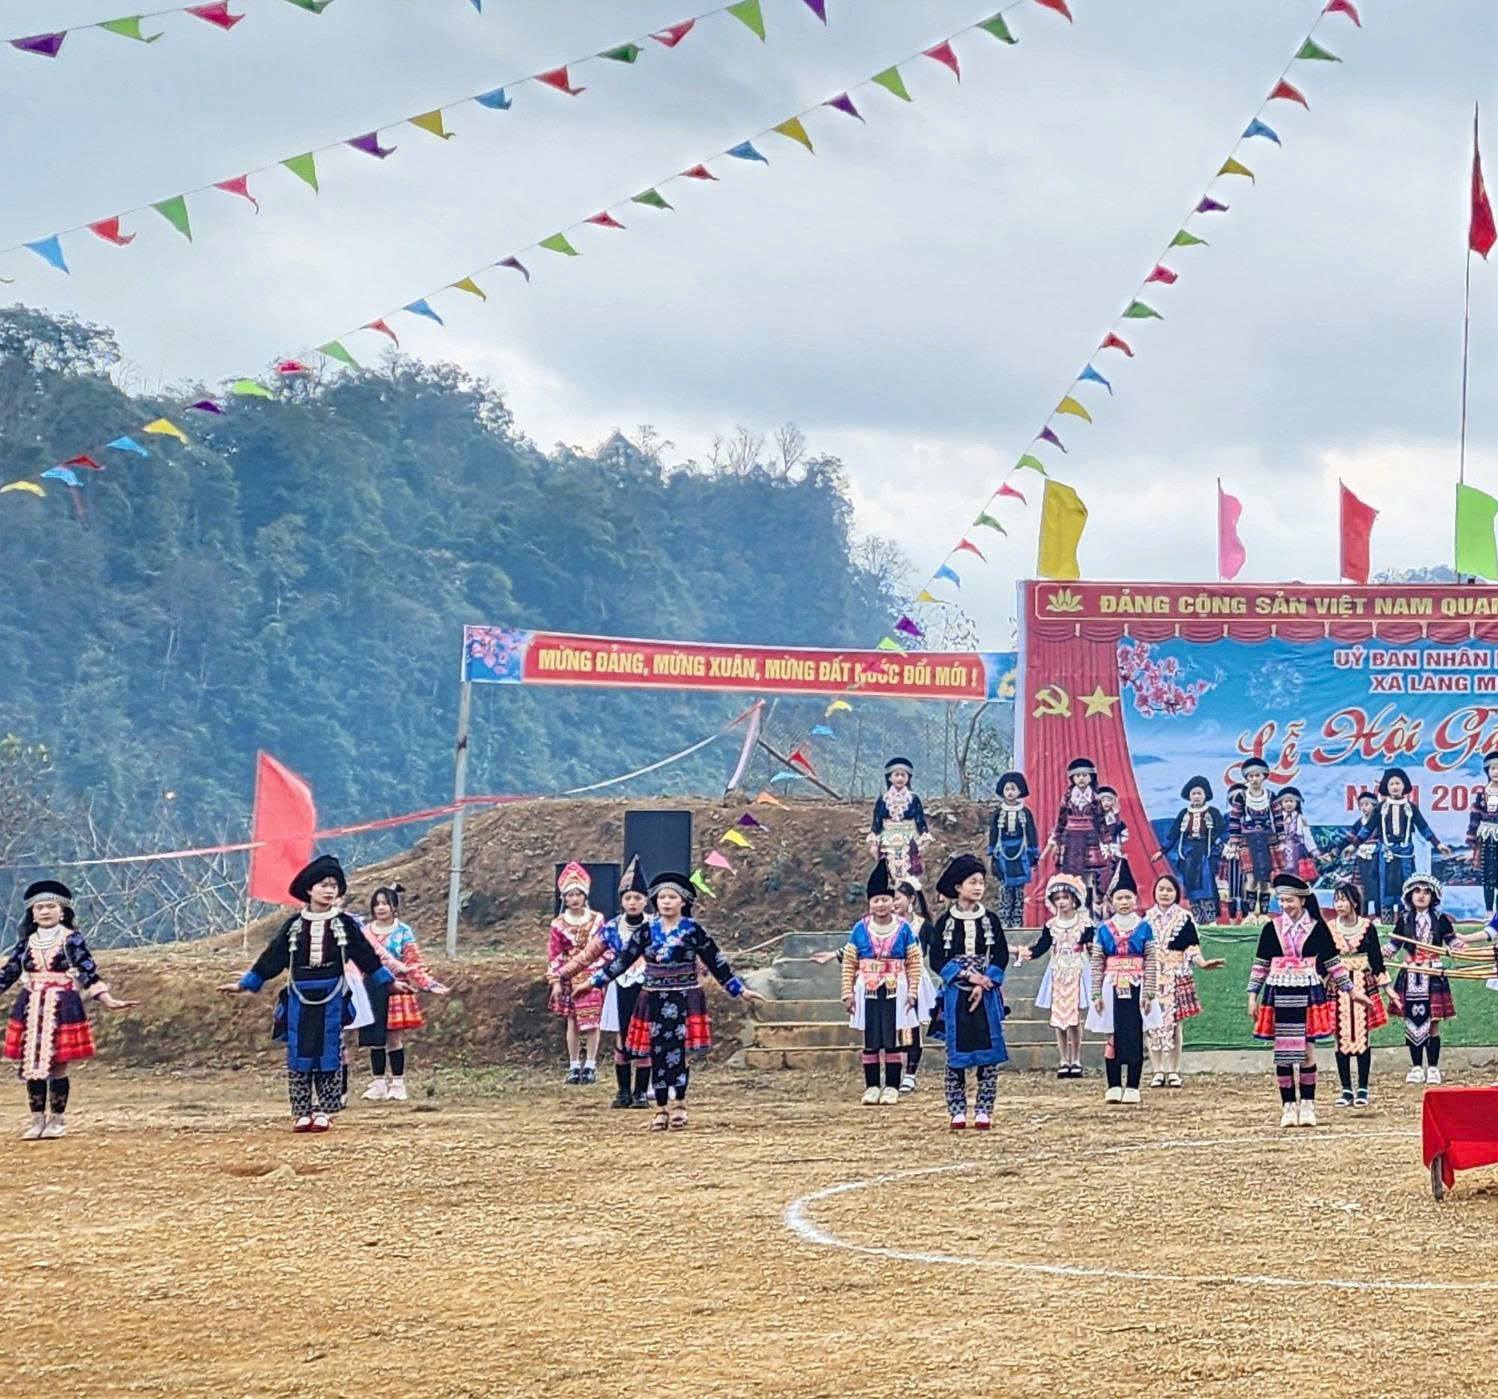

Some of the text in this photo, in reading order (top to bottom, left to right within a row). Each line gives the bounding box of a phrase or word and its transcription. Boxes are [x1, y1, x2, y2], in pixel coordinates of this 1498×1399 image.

[1099, 588, 1170, 614] ĐẢNG
[1178, 592, 1247, 618] CỘNG
[1255, 590, 1307, 615] SẢN
[1313, 592, 1368, 618] VIỆT
[1375, 597, 1433, 615] NAM
[538, 644, 593, 672] MỪNG
[596, 643, 649, 676] ĐẢNG,
[653, 649, 705, 676] MỪNG
[708, 653, 760, 681] XUÂN,
[764, 654, 816, 681] MỪNG
[819, 654, 851, 682] ĐẤT
[935, 660, 966, 687] MỚI
[1371, 651, 1419, 667] BAN
[1426, 648, 1489, 667] NHÂN
[1311, 703, 1424, 762] Hội
